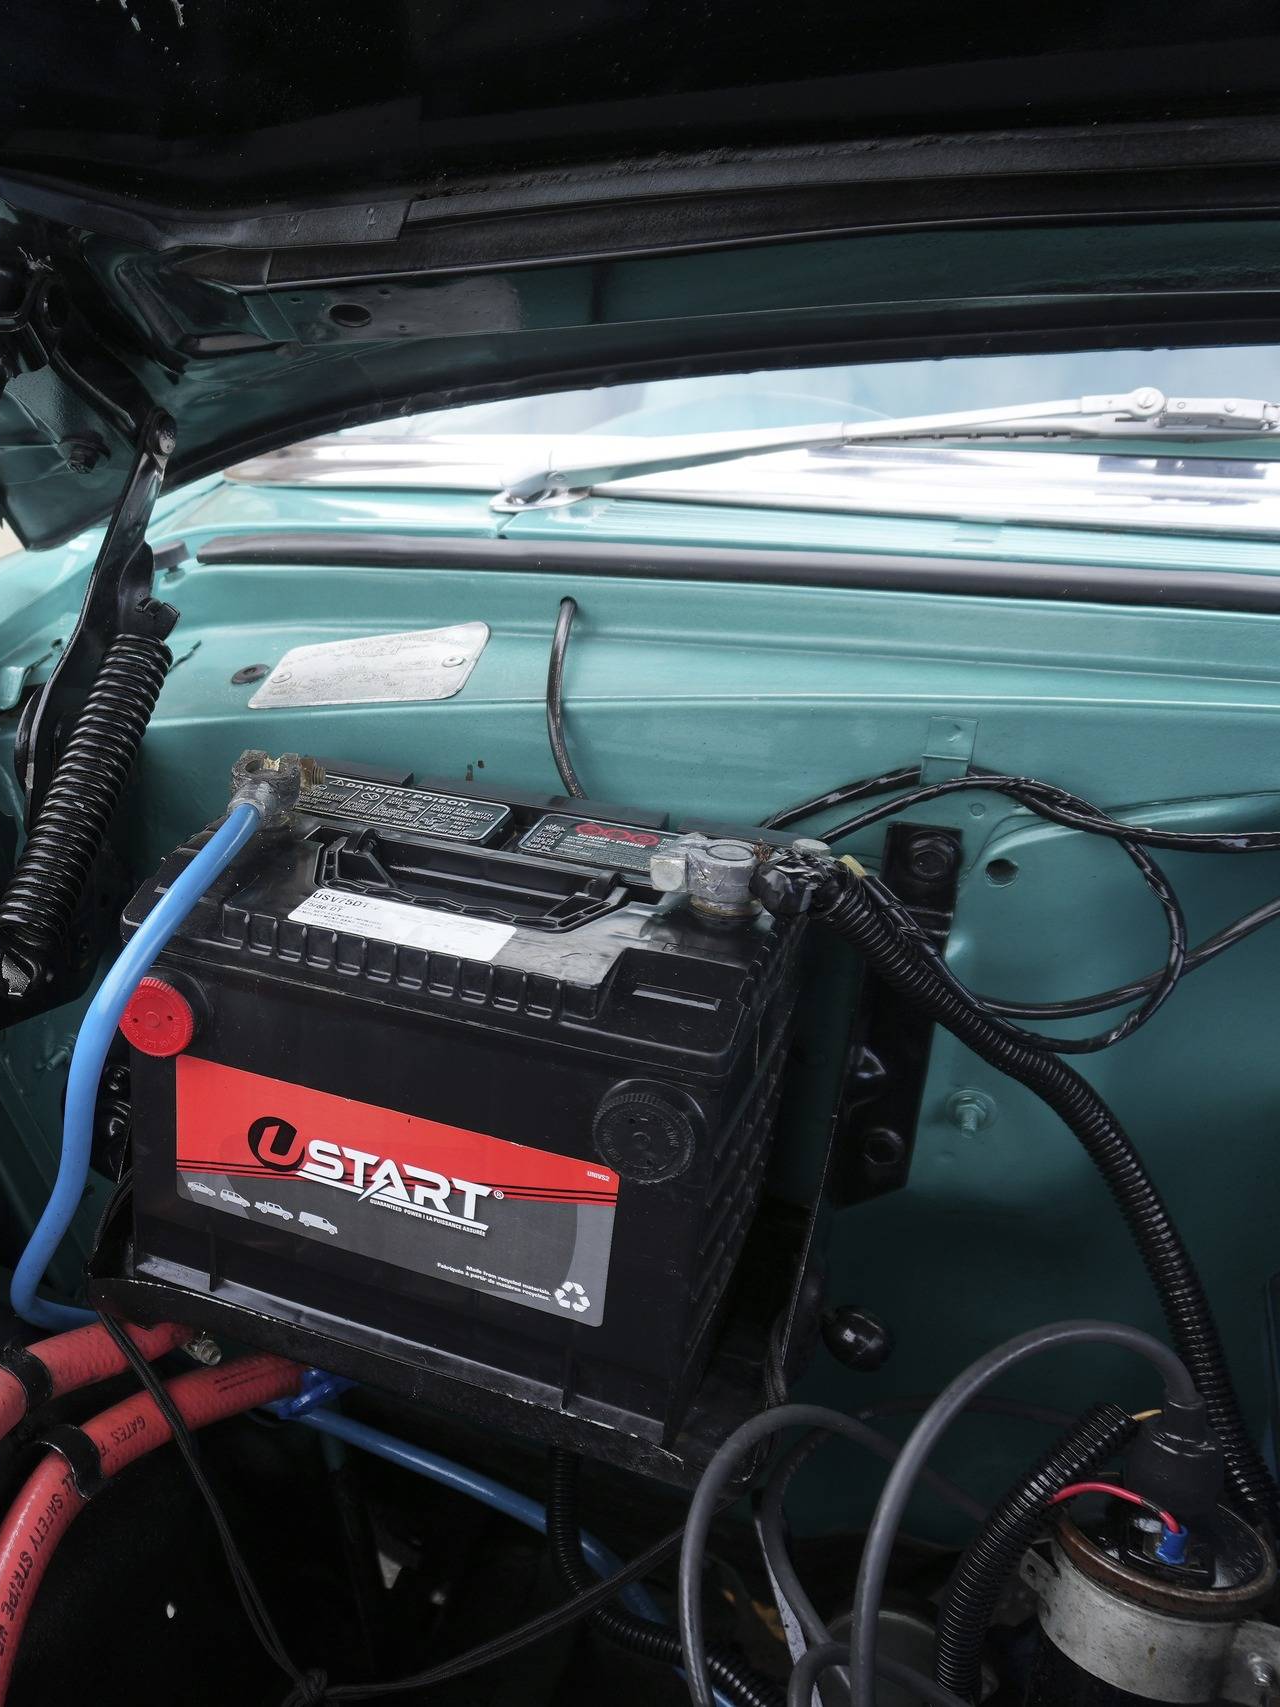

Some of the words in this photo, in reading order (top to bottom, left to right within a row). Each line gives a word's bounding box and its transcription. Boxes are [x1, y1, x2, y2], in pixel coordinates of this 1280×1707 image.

[369, 1198, 402, 1213] GUARANTEED
[404, 1208, 422, 1219] POWER
[483, 1270, 497, 1279] from
[110, 1415, 146, 1446] GATES
[29, 1492, 64, 1552] SAFETY
